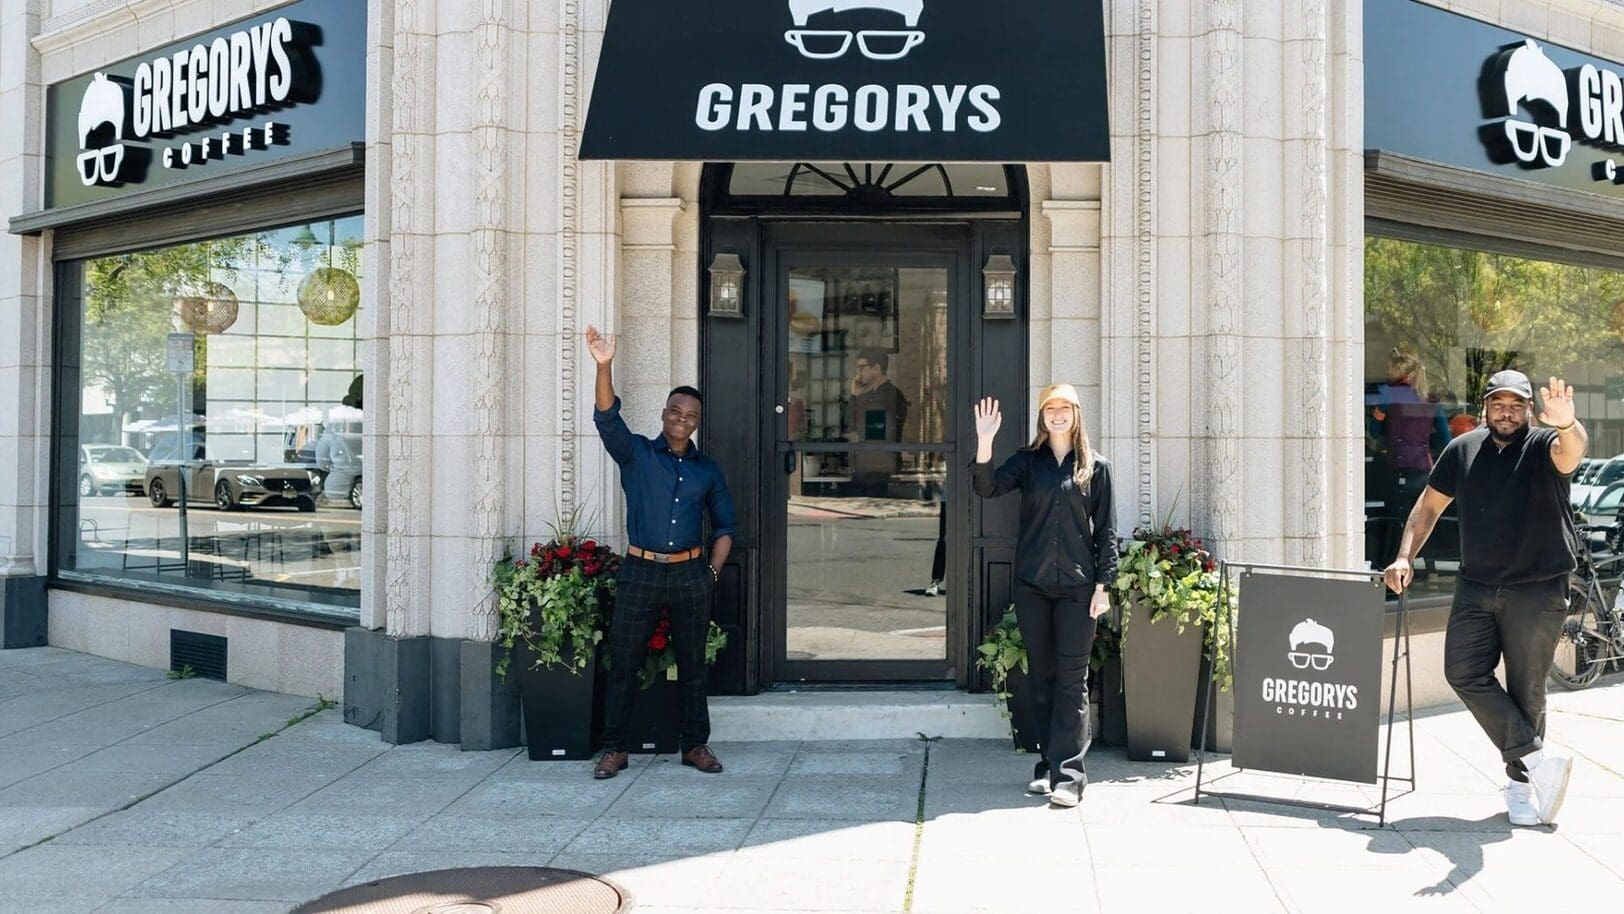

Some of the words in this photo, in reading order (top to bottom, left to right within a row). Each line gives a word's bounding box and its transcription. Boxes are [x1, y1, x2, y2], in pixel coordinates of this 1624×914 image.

[133, 17, 292, 137] GREGORYS
[695, 82, 1001, 132] GREGORYS
[162, 121, 273, 169] COFFEE
[1262, 677, 1358, 710] GREGORYS
[1276, 706, 1343, 720] COFFEE
